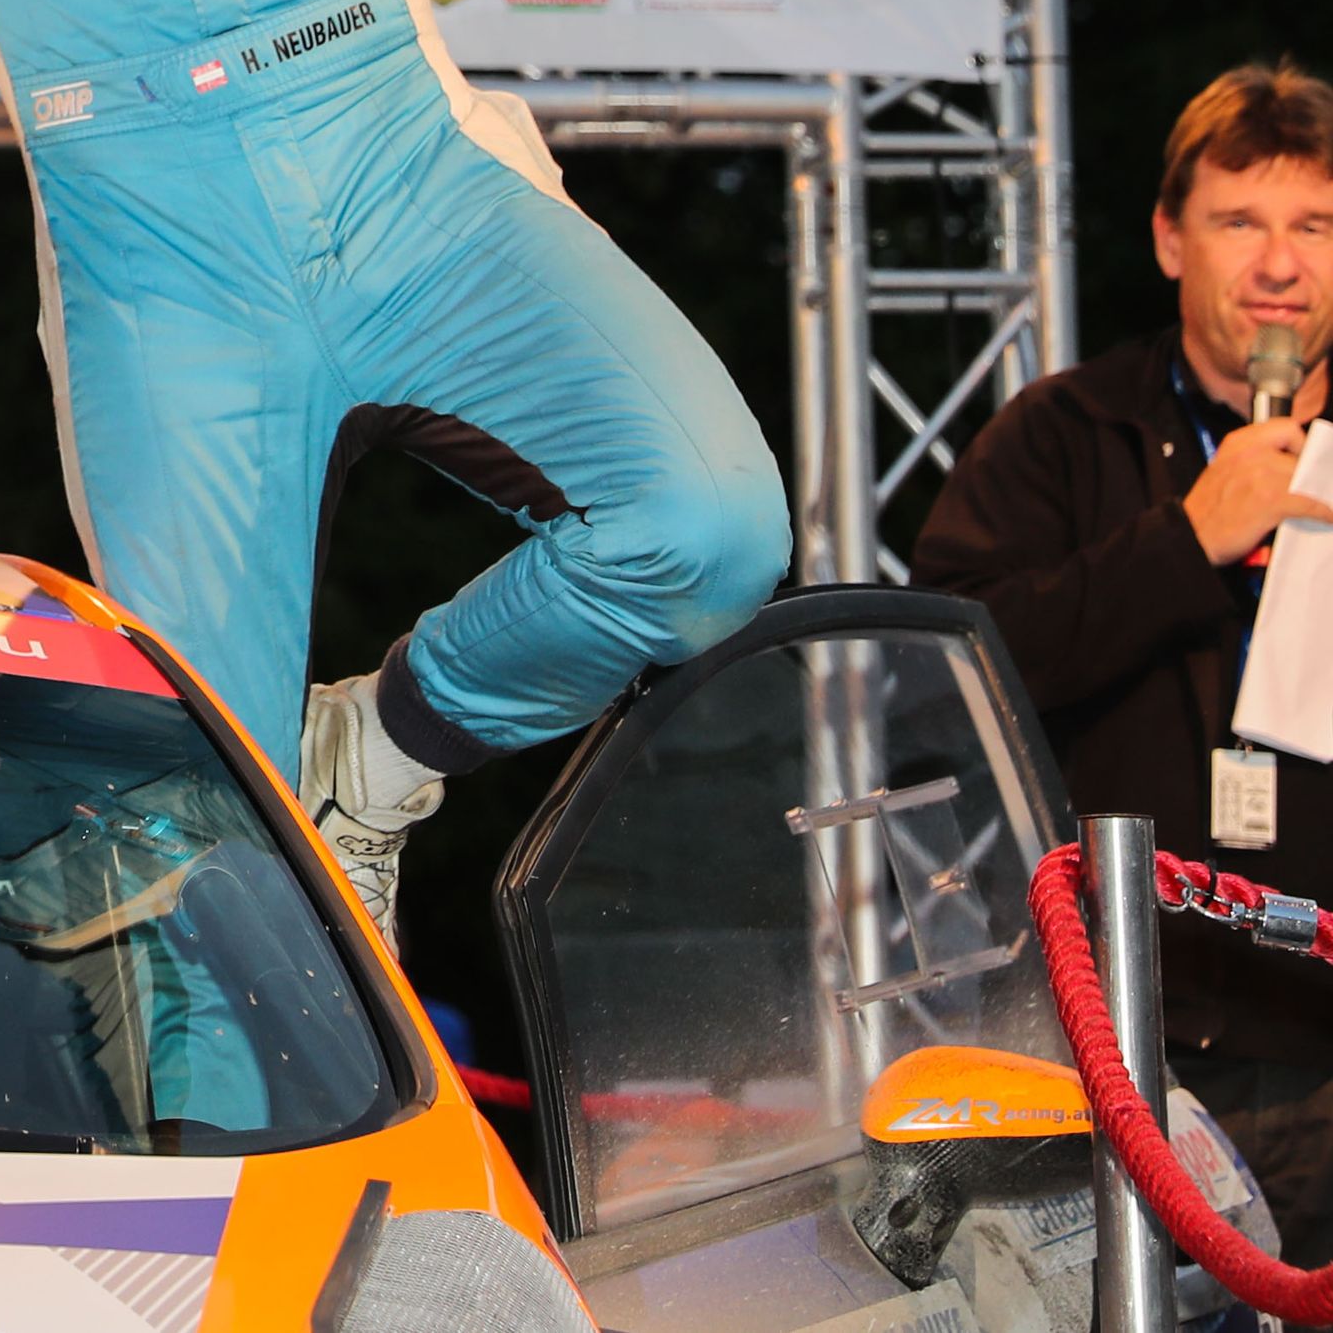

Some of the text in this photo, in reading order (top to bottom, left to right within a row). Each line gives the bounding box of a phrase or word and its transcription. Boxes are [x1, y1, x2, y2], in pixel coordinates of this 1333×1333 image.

[241, 1, 377, 74] H. NEUBAUER
[35, 90, 94, 121] OMP
